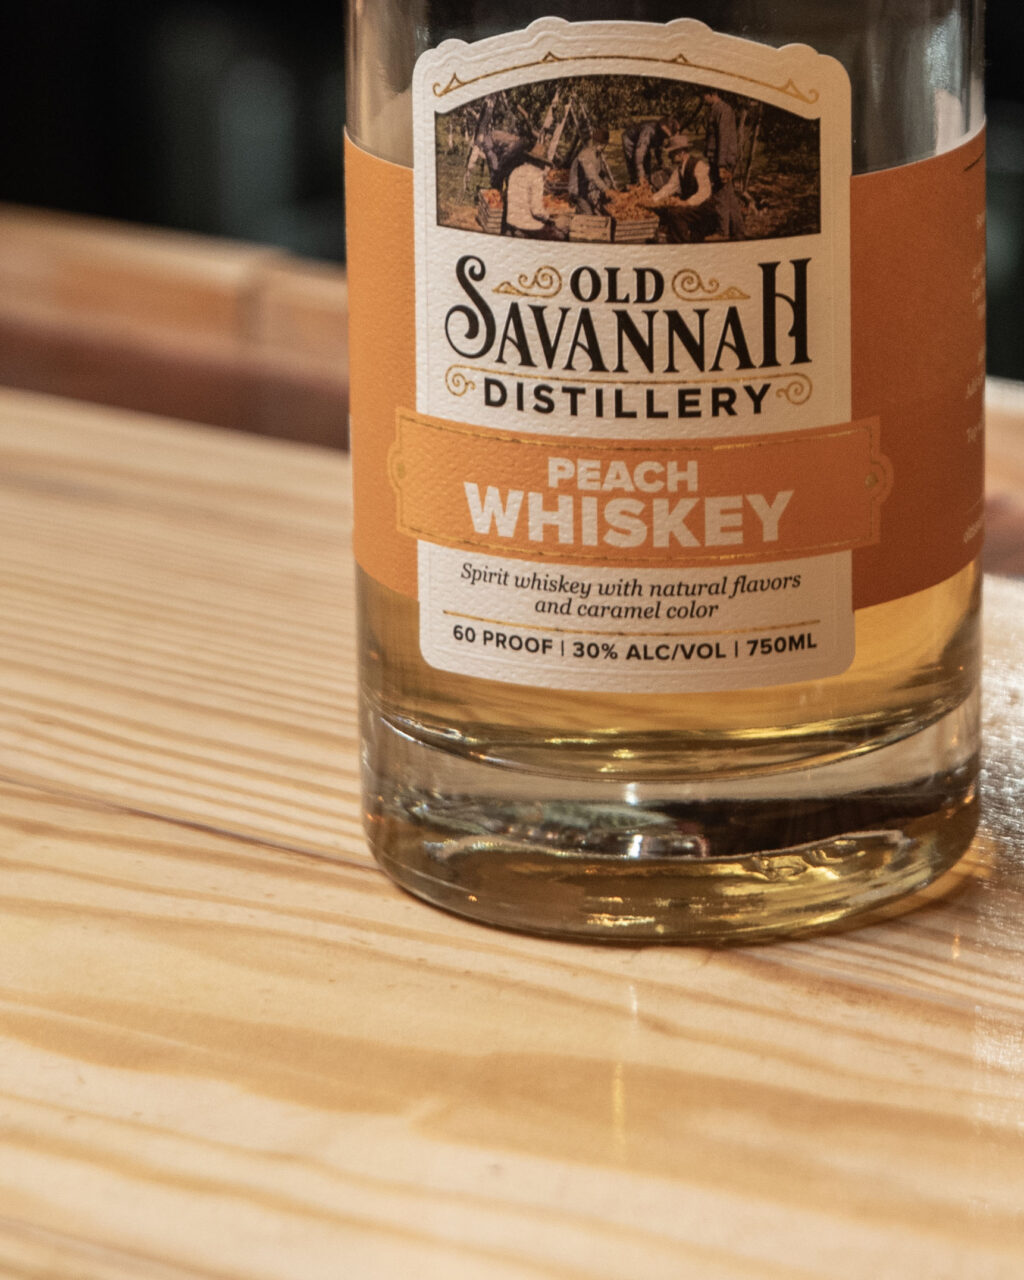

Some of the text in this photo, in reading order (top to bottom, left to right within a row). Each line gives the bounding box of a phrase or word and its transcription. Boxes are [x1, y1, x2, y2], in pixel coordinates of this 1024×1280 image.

[570, 266, 664, 304] OLD
[445, 255, 812, 374] SAVANNAH
[484, 378, 771, 419] DISTILLERY
[548, 457, 698, 493] PEACH
[463, 482, 794, 548] WHISKEY
[460, 562, 801, 599] Spirit whiskey with natural flavors
[535, 598, 719, 619] and caramel color
[453, 625, 817, 660] 60 PROOF 30% ALC/VOL 750ML
